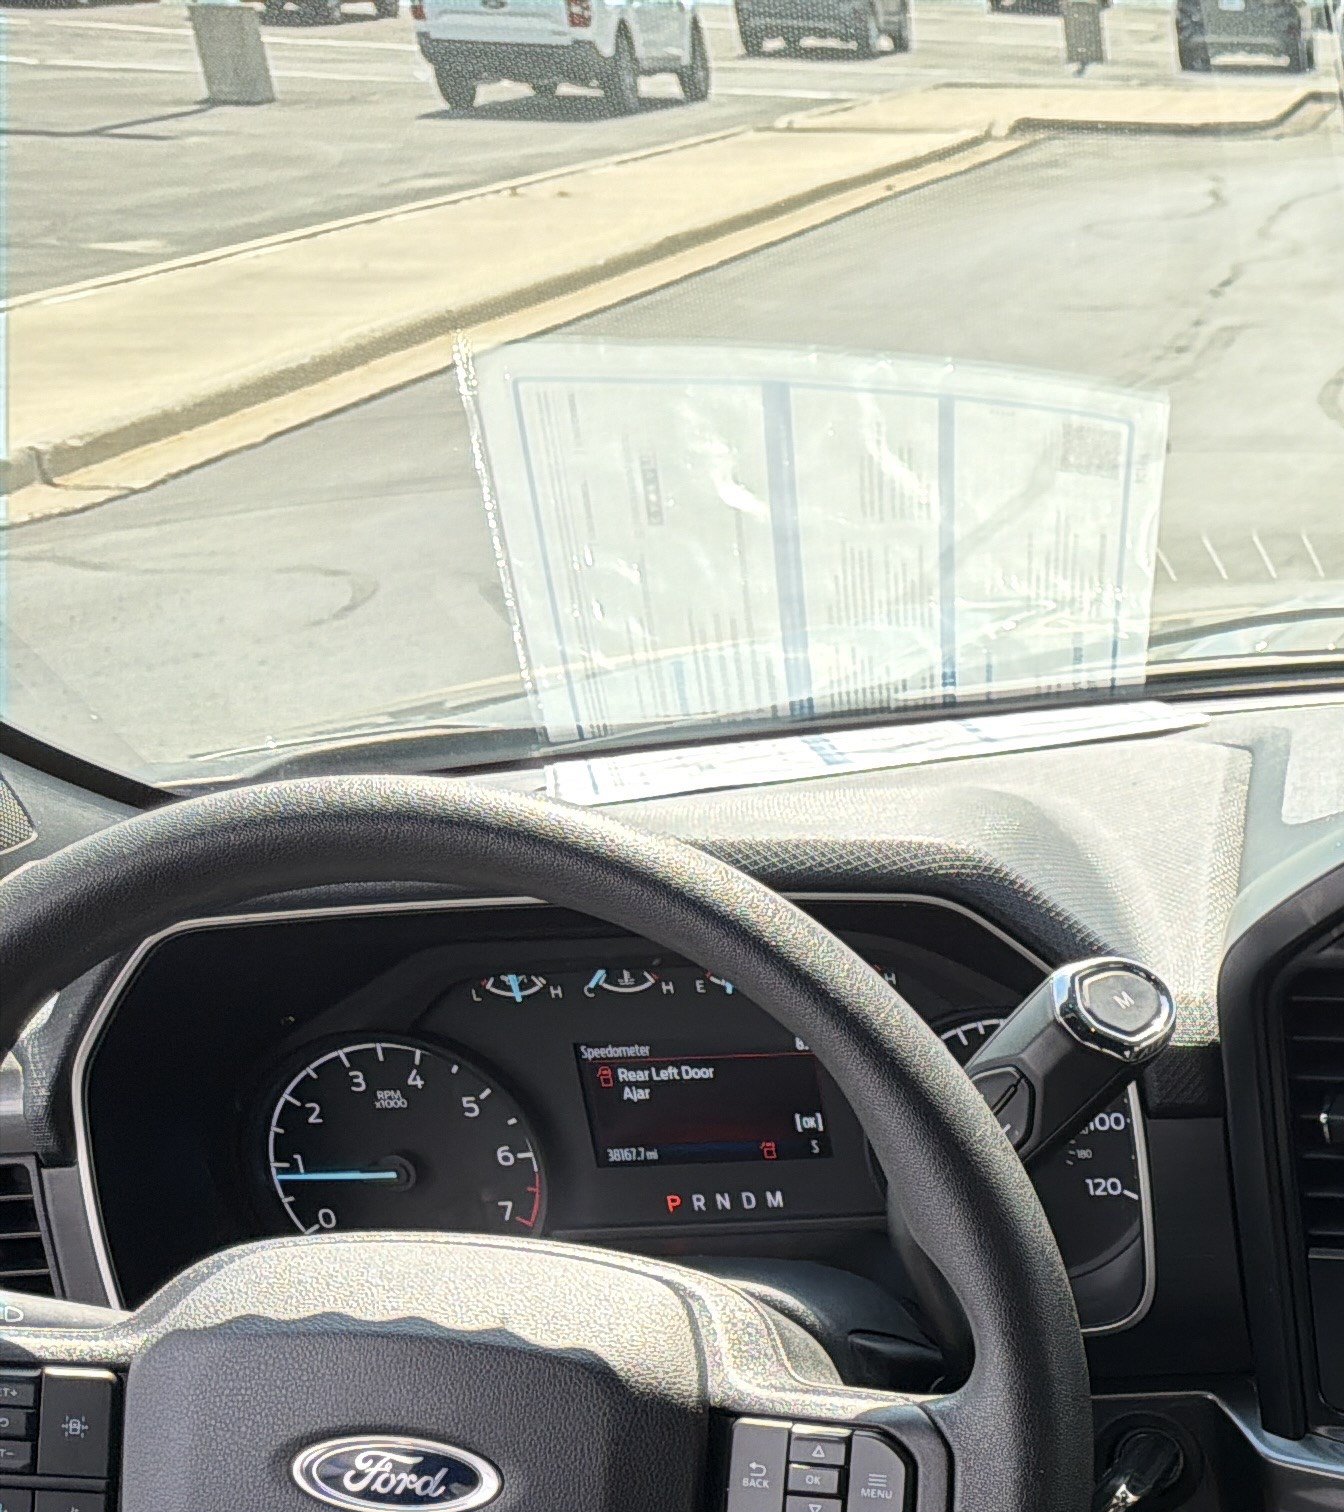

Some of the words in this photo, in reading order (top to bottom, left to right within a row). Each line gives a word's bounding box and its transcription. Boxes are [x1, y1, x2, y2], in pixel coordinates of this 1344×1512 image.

[550, 985, 563, 999] H
[584, 985, 595, 998] C
[661, 980, 675, 995] H
[696, 979, 706, 994] E
[472, 989, 482, 1002] L
[1112, 991, 1135, 1010] M
[580, 1045, 650, 1059] Speedometer
[349, 1071, 366, 1092] 3
[407, 1069, 424, 1089] 4
[617, 1068, 650, 1082] Rear
[651, 1066, 680, 1081] Left
[681, 1065, 715, 1080] Door
[376, 1090, 401, 1100] RPM
[623, 1086, 650, 1102] Ajar
[305, 1103, 323, 1124] 2
[462, 1096, 480, 1118] 5
[496, 1146, 515, 1167] 6
[1085, 1178, 1122, 1196] 120
[666, 1195, 681, 1212] P
[692, 1194, 706, 1211] R
[716, 1193, 731, 1210] N
[742, 1191, 756, 1209] D
[766, 1190, 784, 1208] M
[318, 1208, 336, 1229] 0
[497, 1201, 513, 1221] 7
[343, 1450, 447, 1498] Ford
[805, 1474, 820, 1485] OK
[742, 1477, 770, 1489] BACK
[861, 1488, 893, 1500] MENU
